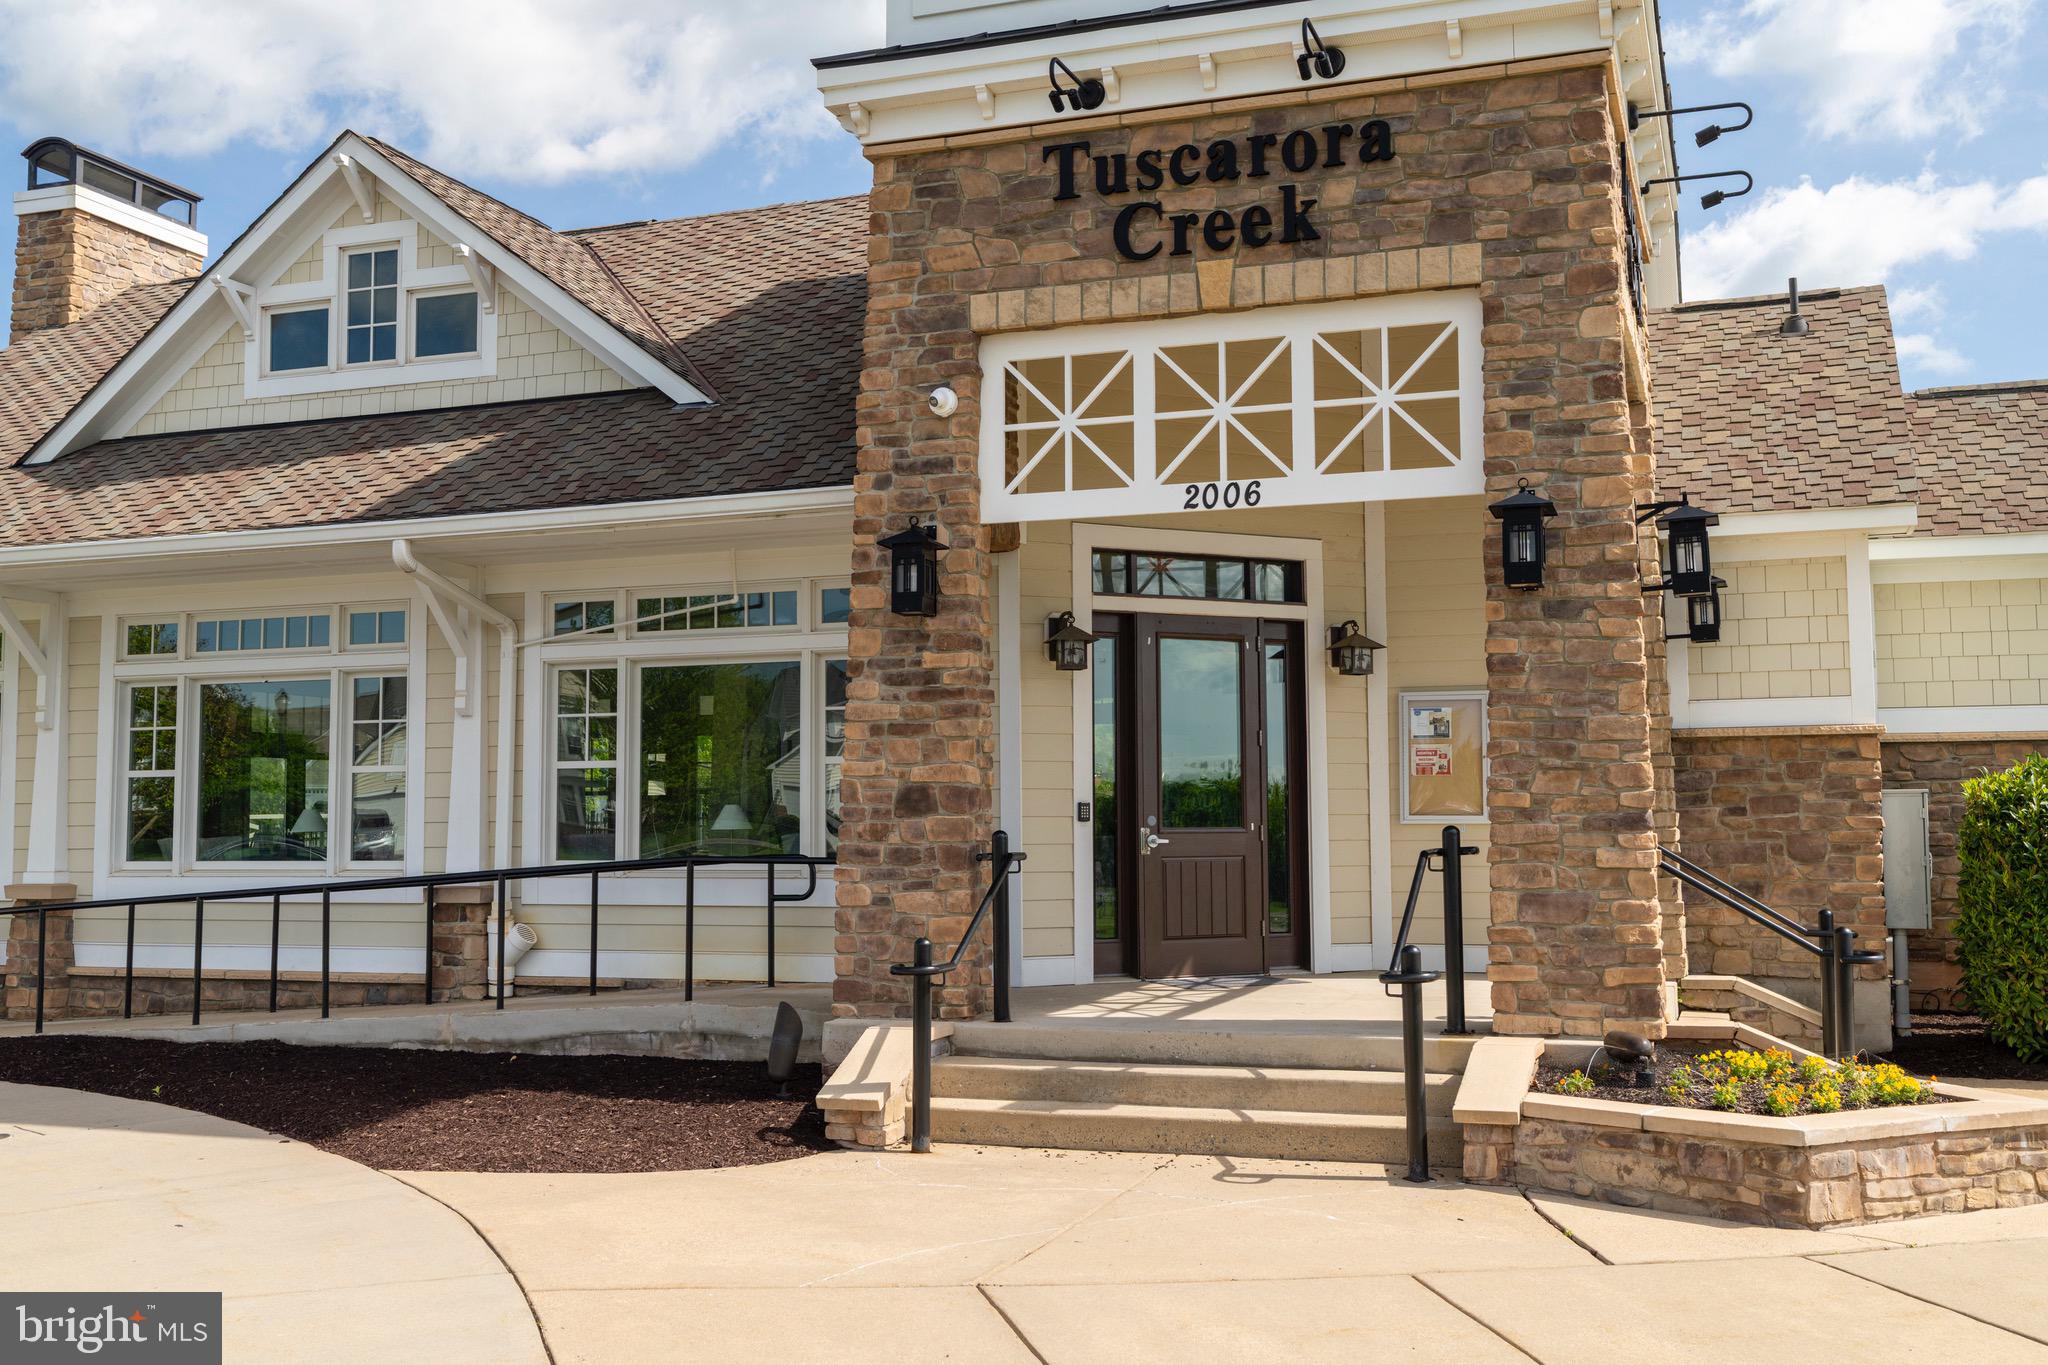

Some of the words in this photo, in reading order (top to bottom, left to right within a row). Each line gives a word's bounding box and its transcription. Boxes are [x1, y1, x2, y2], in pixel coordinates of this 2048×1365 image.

[1043, 119, 1396, 201] Tuscarora
[1113, 184, 1321, 261] Creek
[1184, 480, 1261, 510] 2006
